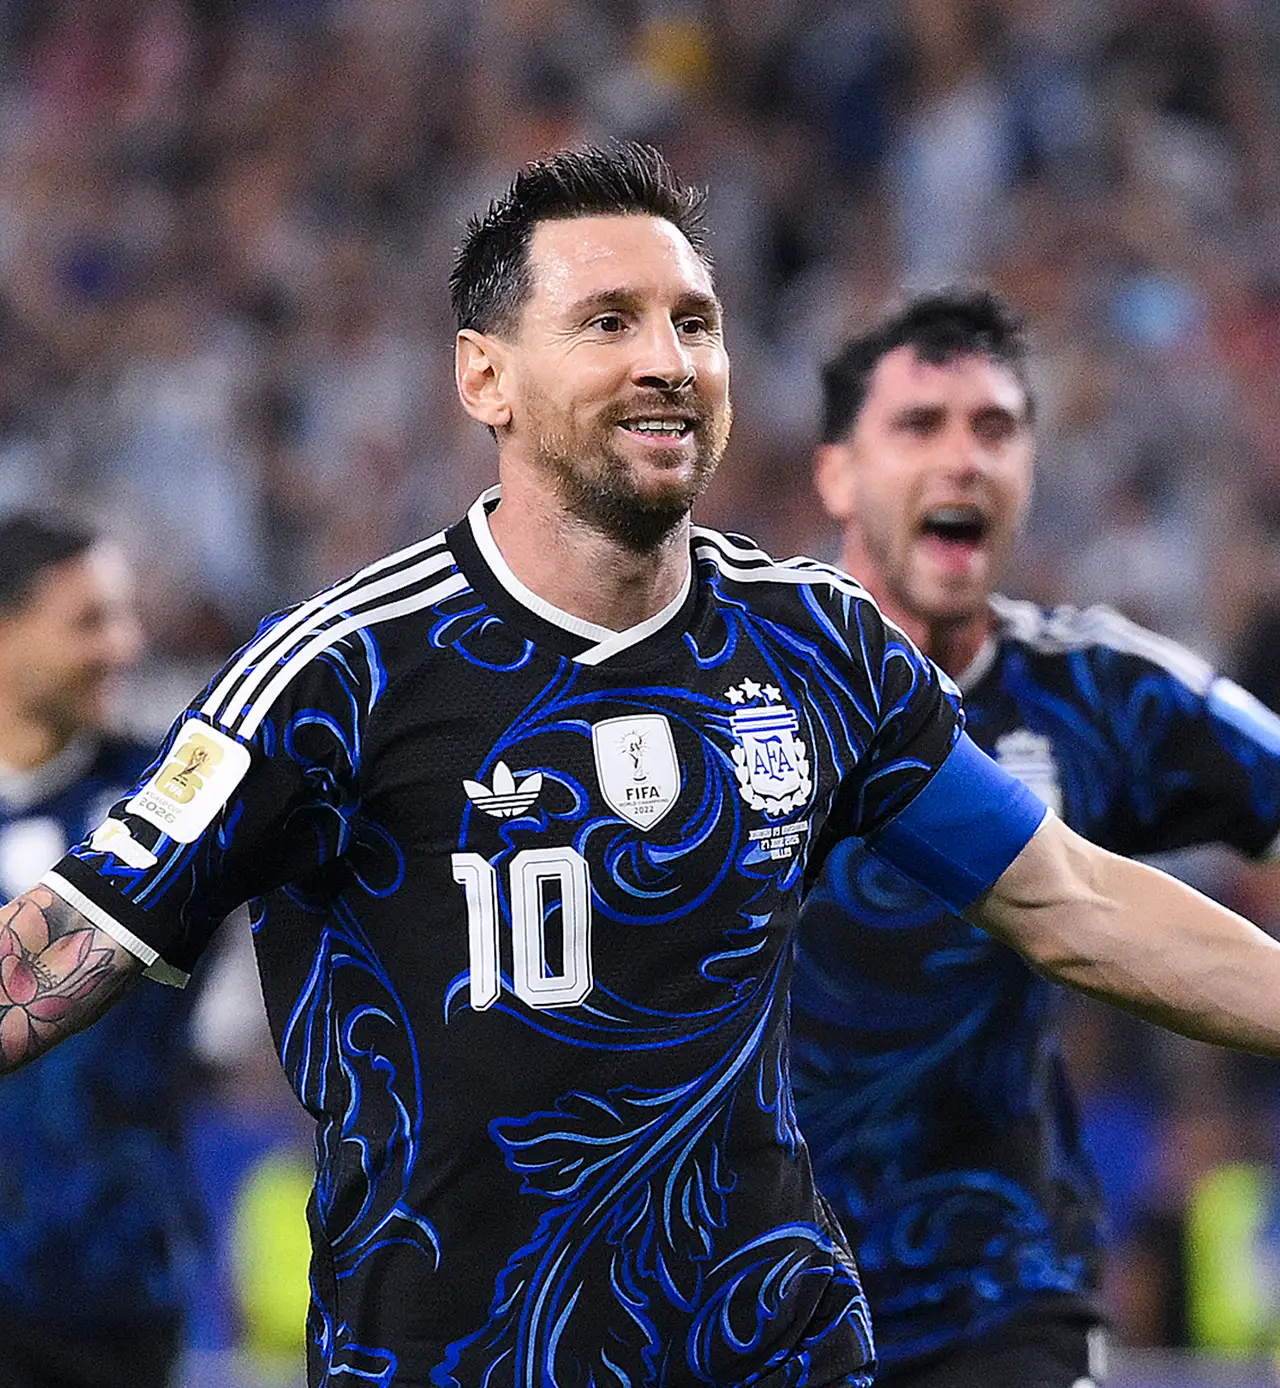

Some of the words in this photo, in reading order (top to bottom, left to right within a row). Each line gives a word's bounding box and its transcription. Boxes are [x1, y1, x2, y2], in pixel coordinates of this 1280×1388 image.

[753, 735, 795, 782] AFA
[626, 786, 660, 801] FIFA
[139, 796, 177, 824] 2026
[634, 805, 654, 815] 2022
[451, 846, 594, 1011] 10
